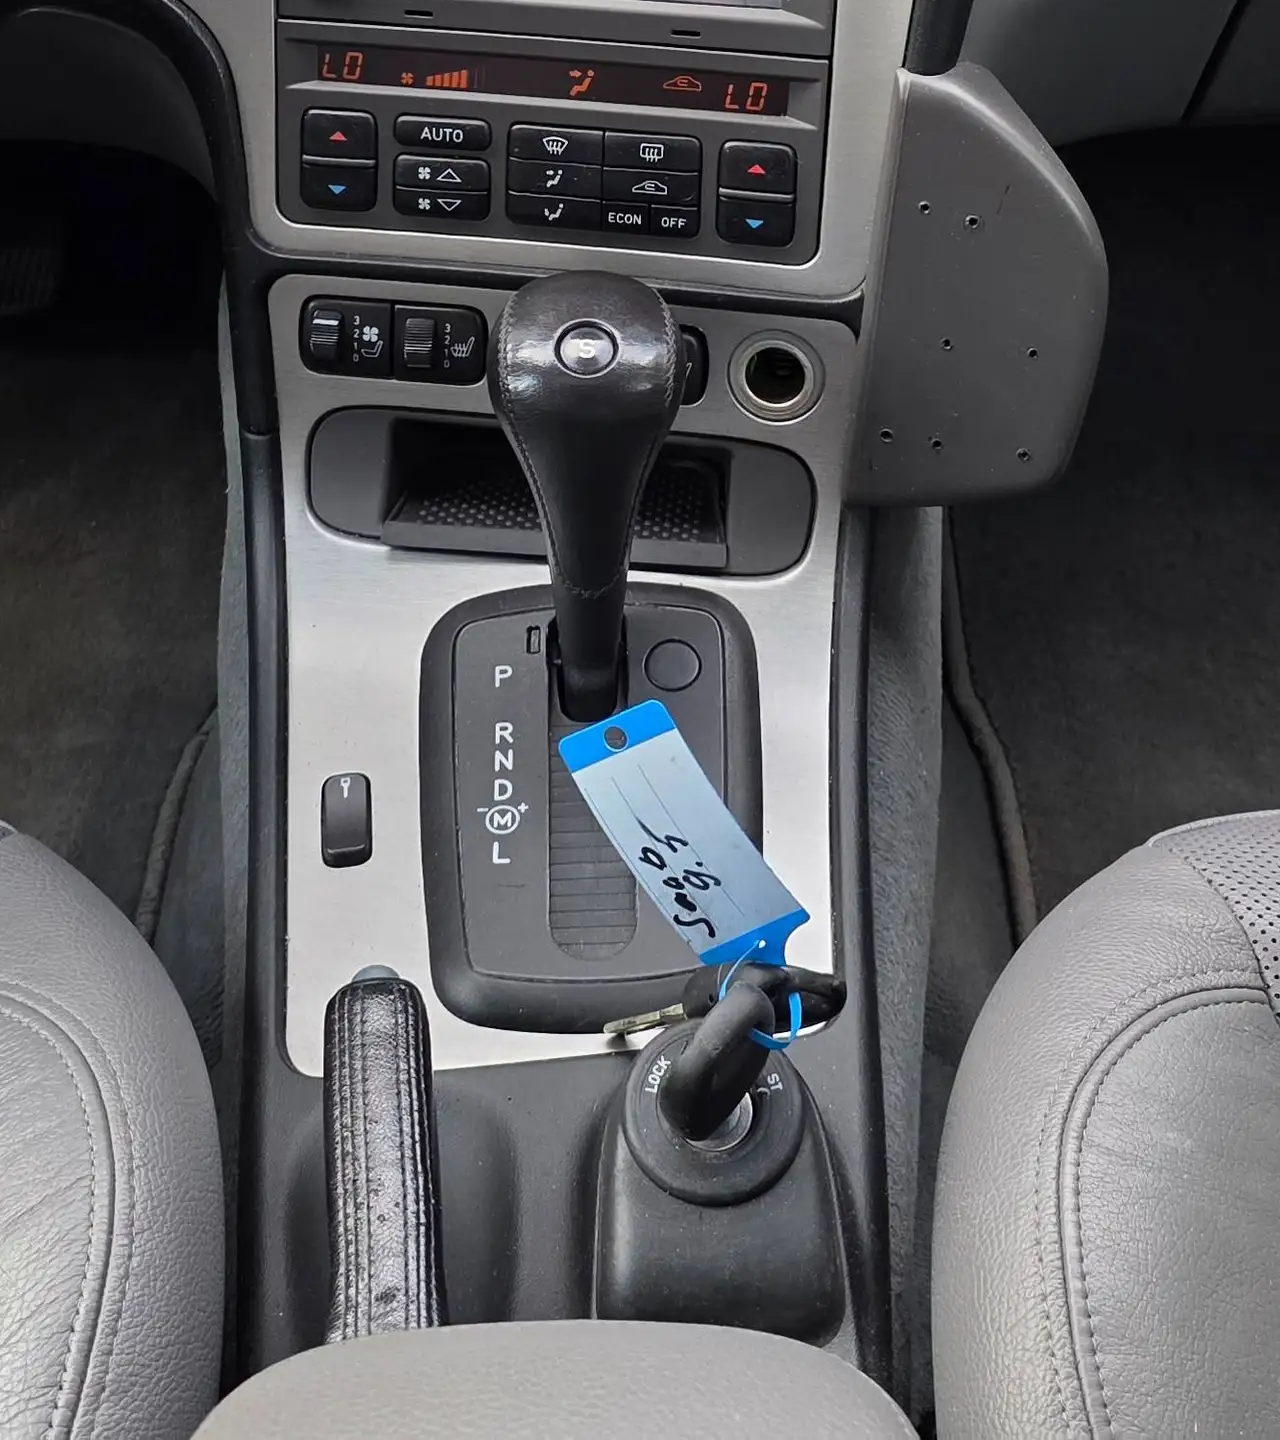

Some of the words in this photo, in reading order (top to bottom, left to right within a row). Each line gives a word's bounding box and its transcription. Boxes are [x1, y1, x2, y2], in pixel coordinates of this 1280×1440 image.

[420, 126, 464, 144] AUTO
[607, 210, 643, 227] ECON
[660, 215, 687, 230] OFF
[353, 315, 360, 326] 3
[443, 323, 451, 333] 3
[577, 340, 597, 359] S
[494, 665, 513, 687] P
[494, 722, 514, 744] R
[494, 749, 514, 772] N
[494, 779, 513, 801] D
[493, 811, 512, 828] M
[492, 841, 511, 864] L
[644, 1055, 671, 1094] LOCK
